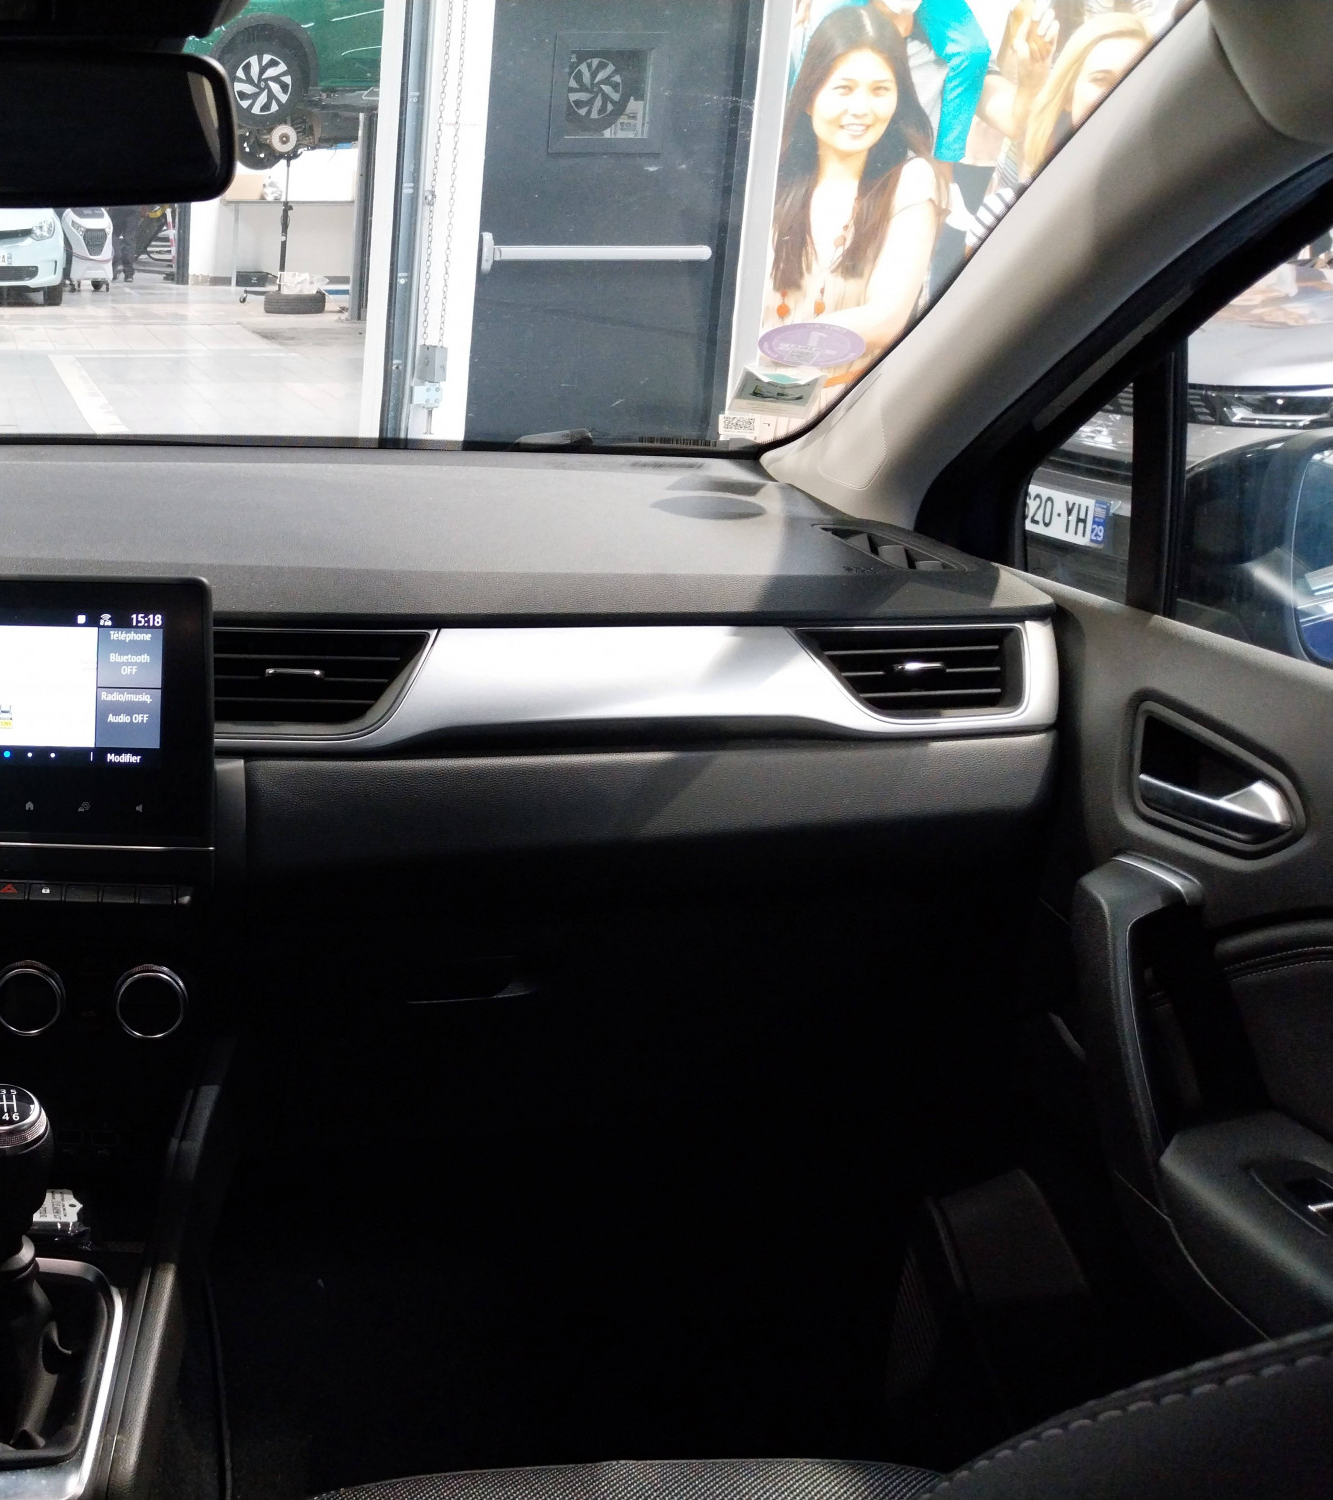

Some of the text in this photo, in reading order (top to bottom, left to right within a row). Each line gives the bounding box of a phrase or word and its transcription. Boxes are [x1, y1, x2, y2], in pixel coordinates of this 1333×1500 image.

[1091, 525, 1104, 541] 29
[131, 613, 163, 627] 15:18
[109, 630, 152, 643] Téléphone
[109, 652, 150, 663] Bluetooth
[121, 665, 138, 675] OFF
[101, 692, 153, 704] Radio/musiq.
[107, 714, 149, 724] Audio OFF
[107, 753, 141, 764] Modifier
[2, 1113, 10, 1121] 4
[12, 1112, 20, 1121] 6
